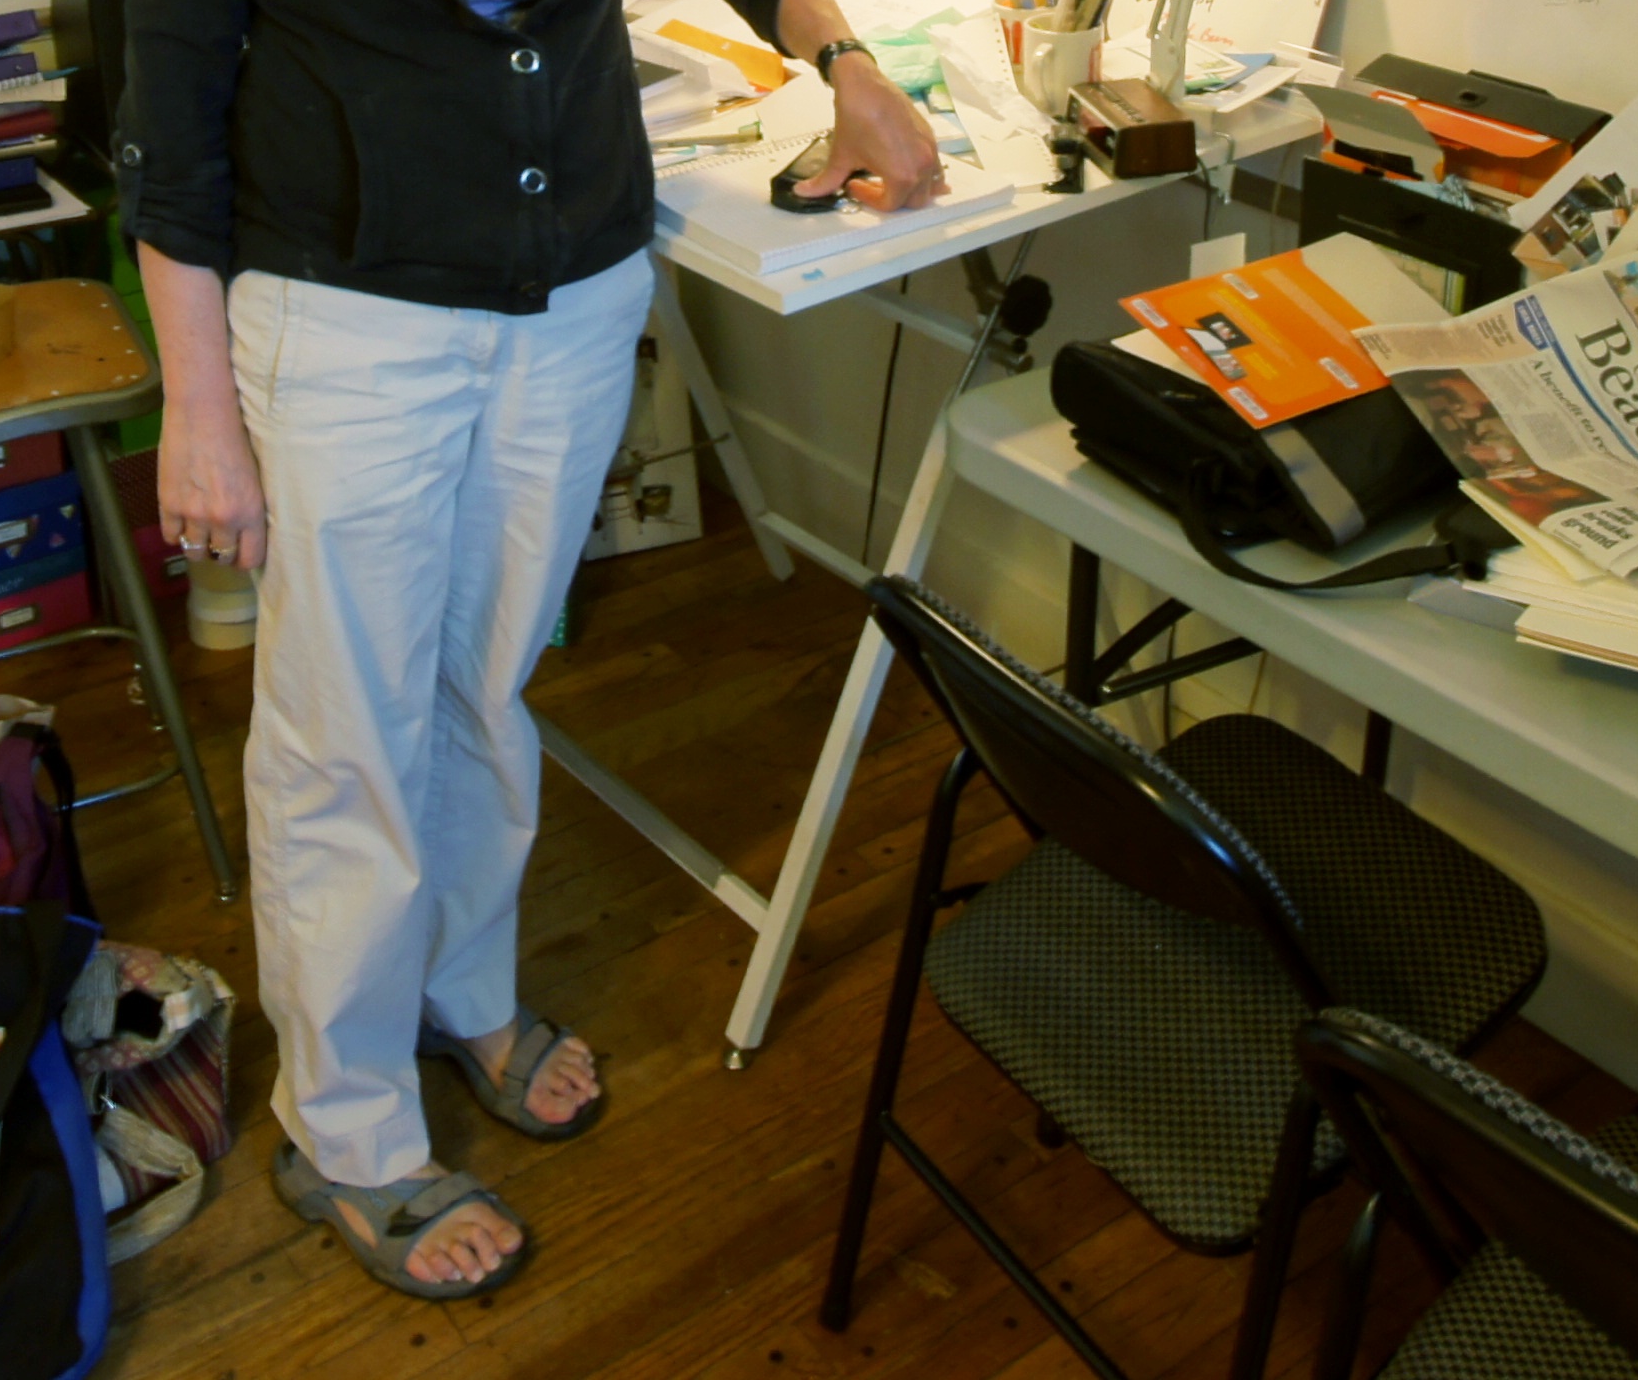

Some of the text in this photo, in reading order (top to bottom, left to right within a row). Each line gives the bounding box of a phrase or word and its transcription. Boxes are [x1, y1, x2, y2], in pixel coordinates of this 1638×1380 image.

[1530, 358, 1545, 371] A
[1581, 417, 1597, 436] to
[1560, 518, 1620, 551] ground
